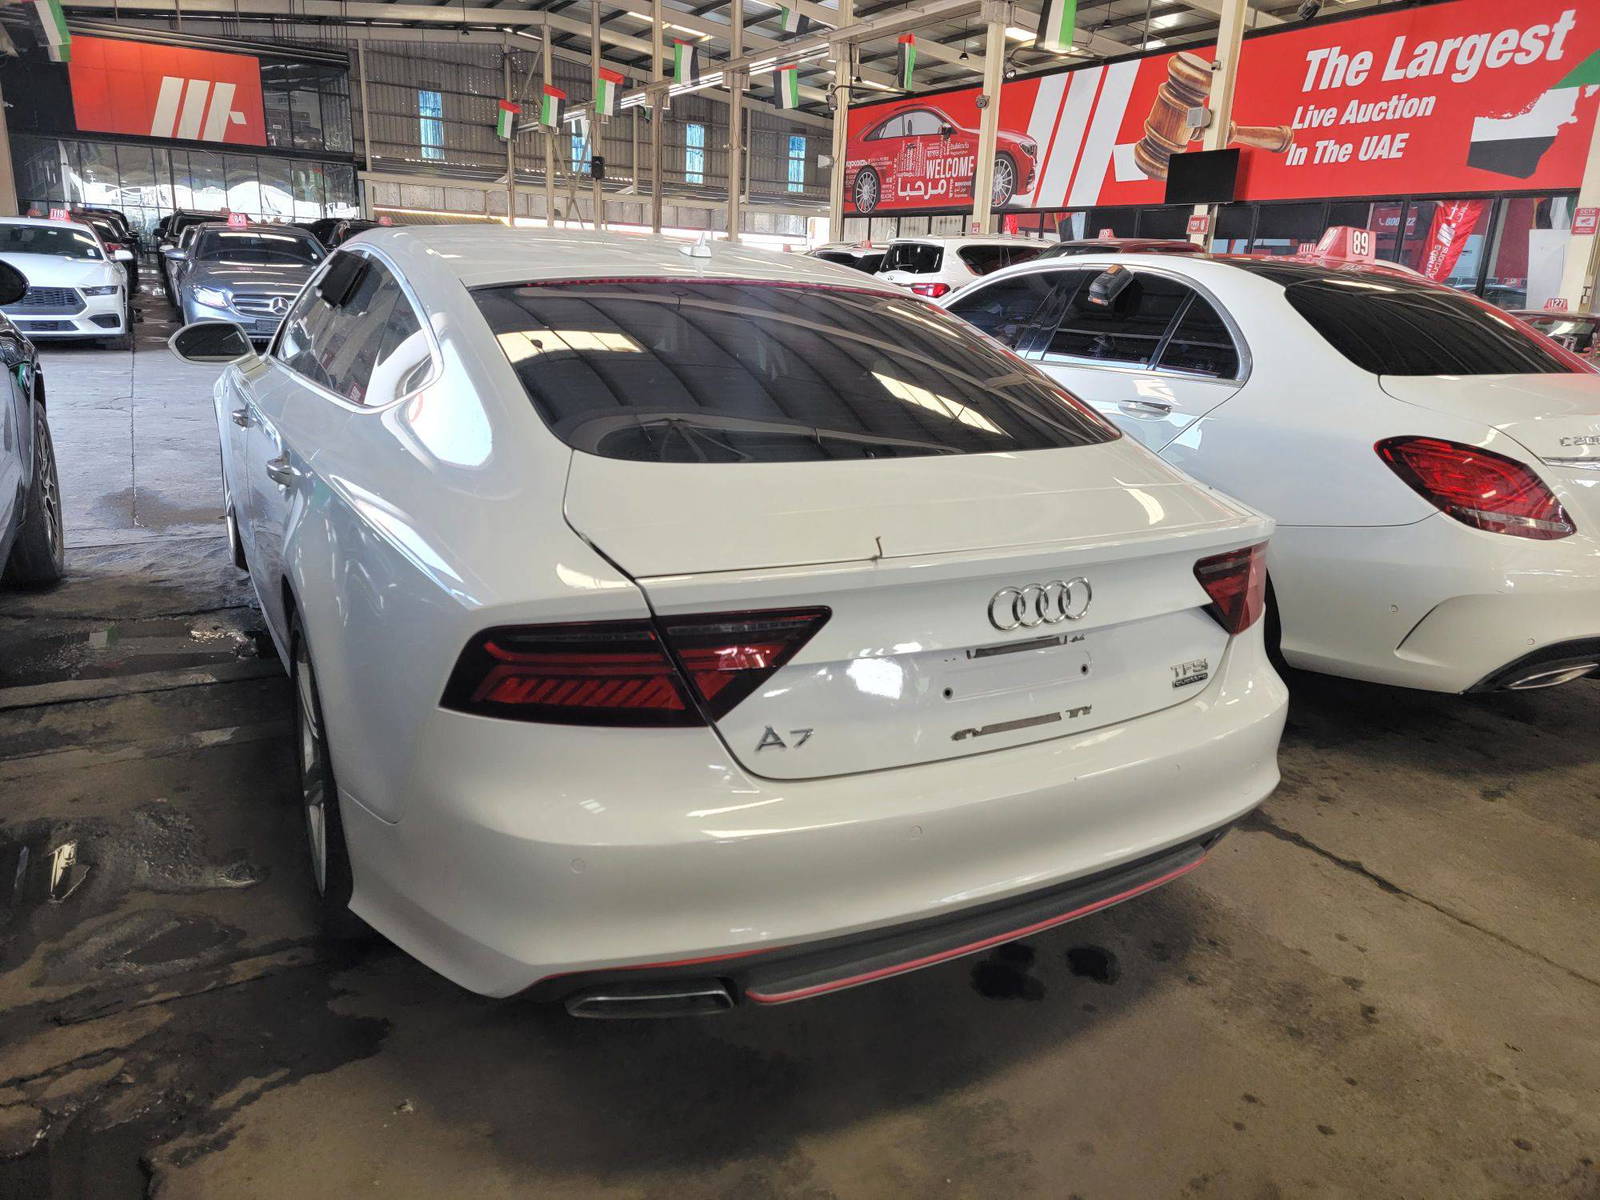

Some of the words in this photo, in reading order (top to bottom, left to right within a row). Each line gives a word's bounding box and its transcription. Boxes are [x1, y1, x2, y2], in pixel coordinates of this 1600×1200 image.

[1301, 46, 1374, 93] The
[1381, 9, 1577, 84] Largest
[1291, 104, 1336, 130] Live
[1339, 93, 1437, 127] Auction
[1285, 142, 1308, 166] In
[1312, 139, 1353, 163] The
[1358, 132, 1410, 161] UAE
[926, 156, 975, 180] WELCOME
[897, 177, 947, 201] مرحبا
[1352, 230, 1369, 256] 89
[1551, 298, 1564, 308] 127
[755, 726, 814, 752] A7
